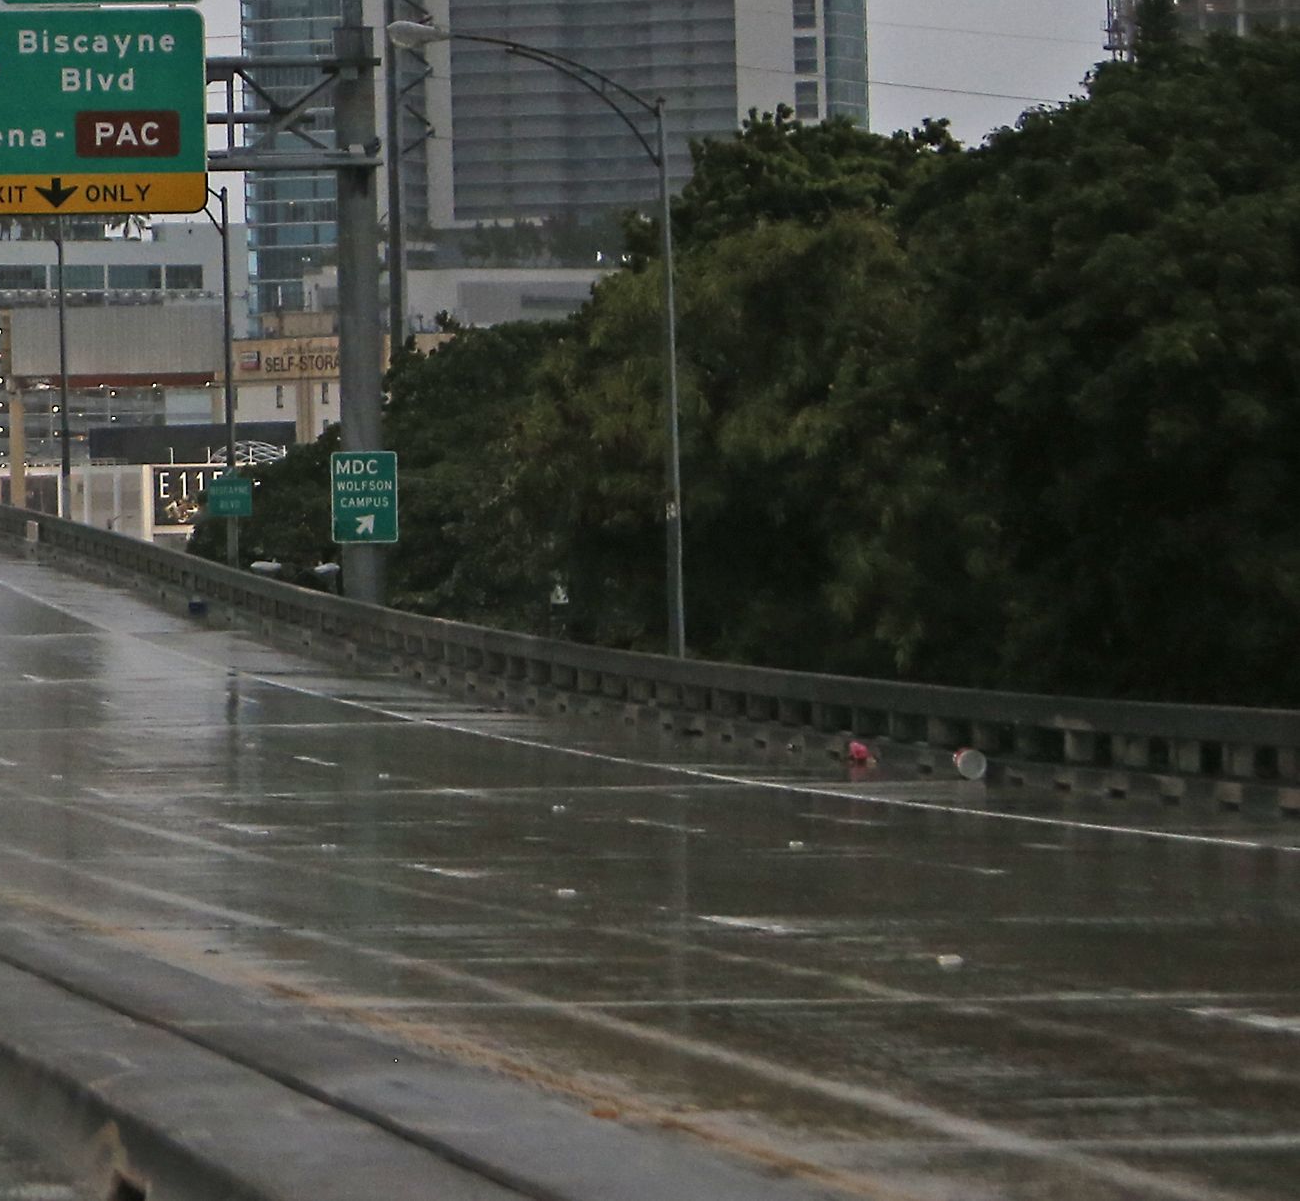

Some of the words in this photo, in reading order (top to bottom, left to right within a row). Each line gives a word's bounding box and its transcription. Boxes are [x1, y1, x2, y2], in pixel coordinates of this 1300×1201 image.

[18, 29, 175, 59] Biscayne
[61, 67, 134, 92] Blvd
[95, 121, 159, 146] PAC
[85, 183, 151, 203] ONLY
[336, 459, 378, 475] MDC
[336, 480, 392, 492] WOLFSON
[340, 496, 389, 508] CAMPUS
